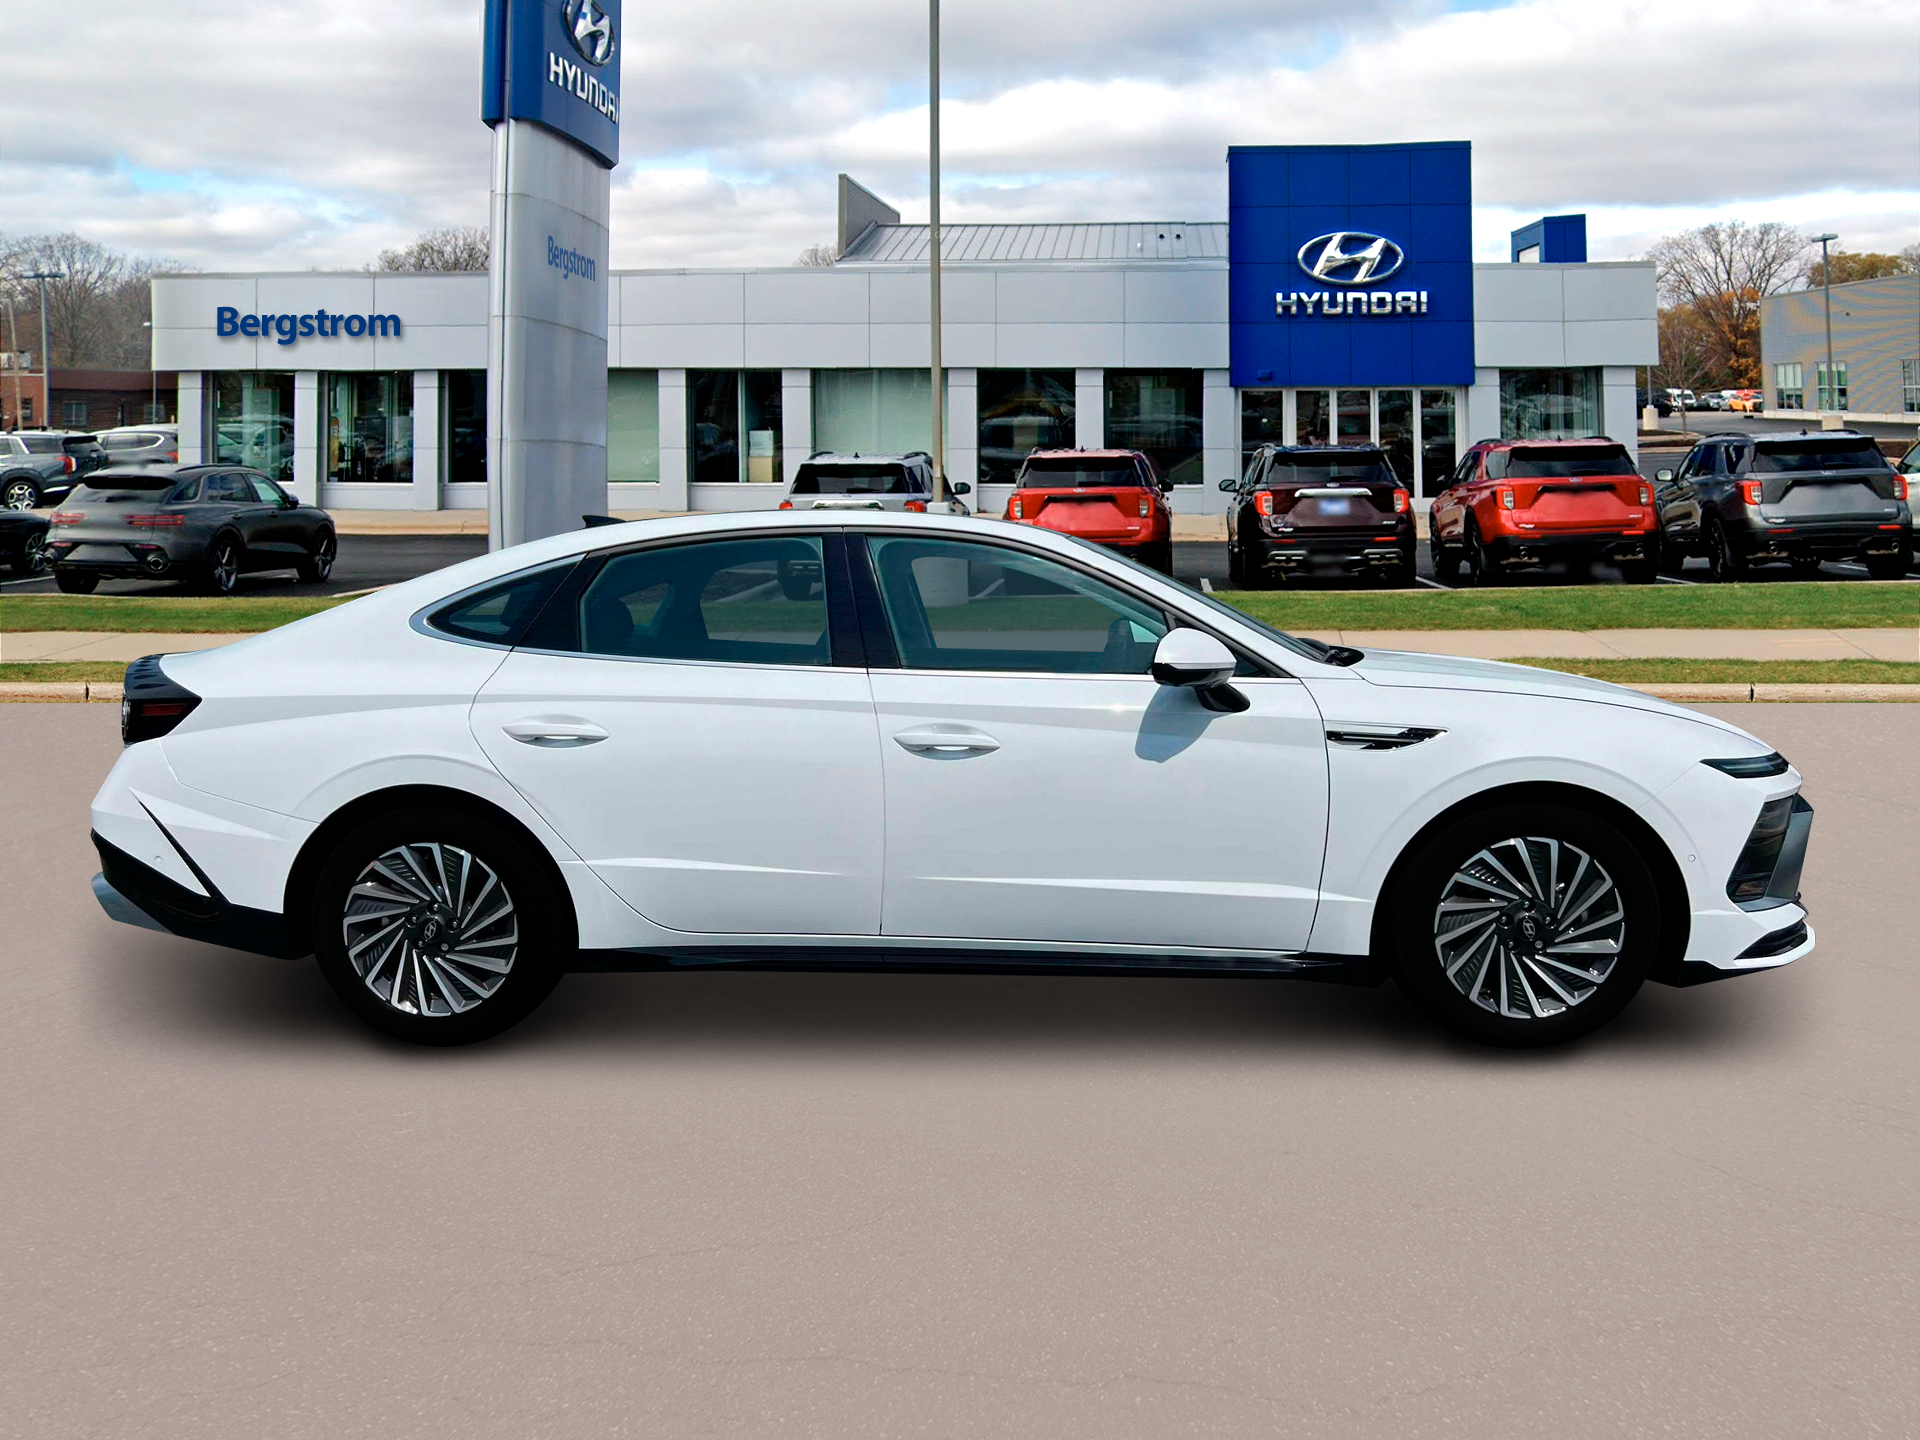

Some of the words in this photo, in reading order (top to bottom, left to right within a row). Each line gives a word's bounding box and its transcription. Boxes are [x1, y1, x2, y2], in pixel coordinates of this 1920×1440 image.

[549, 52, 619, 124] HYUNDAI
[548, 235, 596, 282] Bergstrom
[1275, 291, 1428, 315] HYUNDAI
[216, 306, 402, 346] Bergstrom
